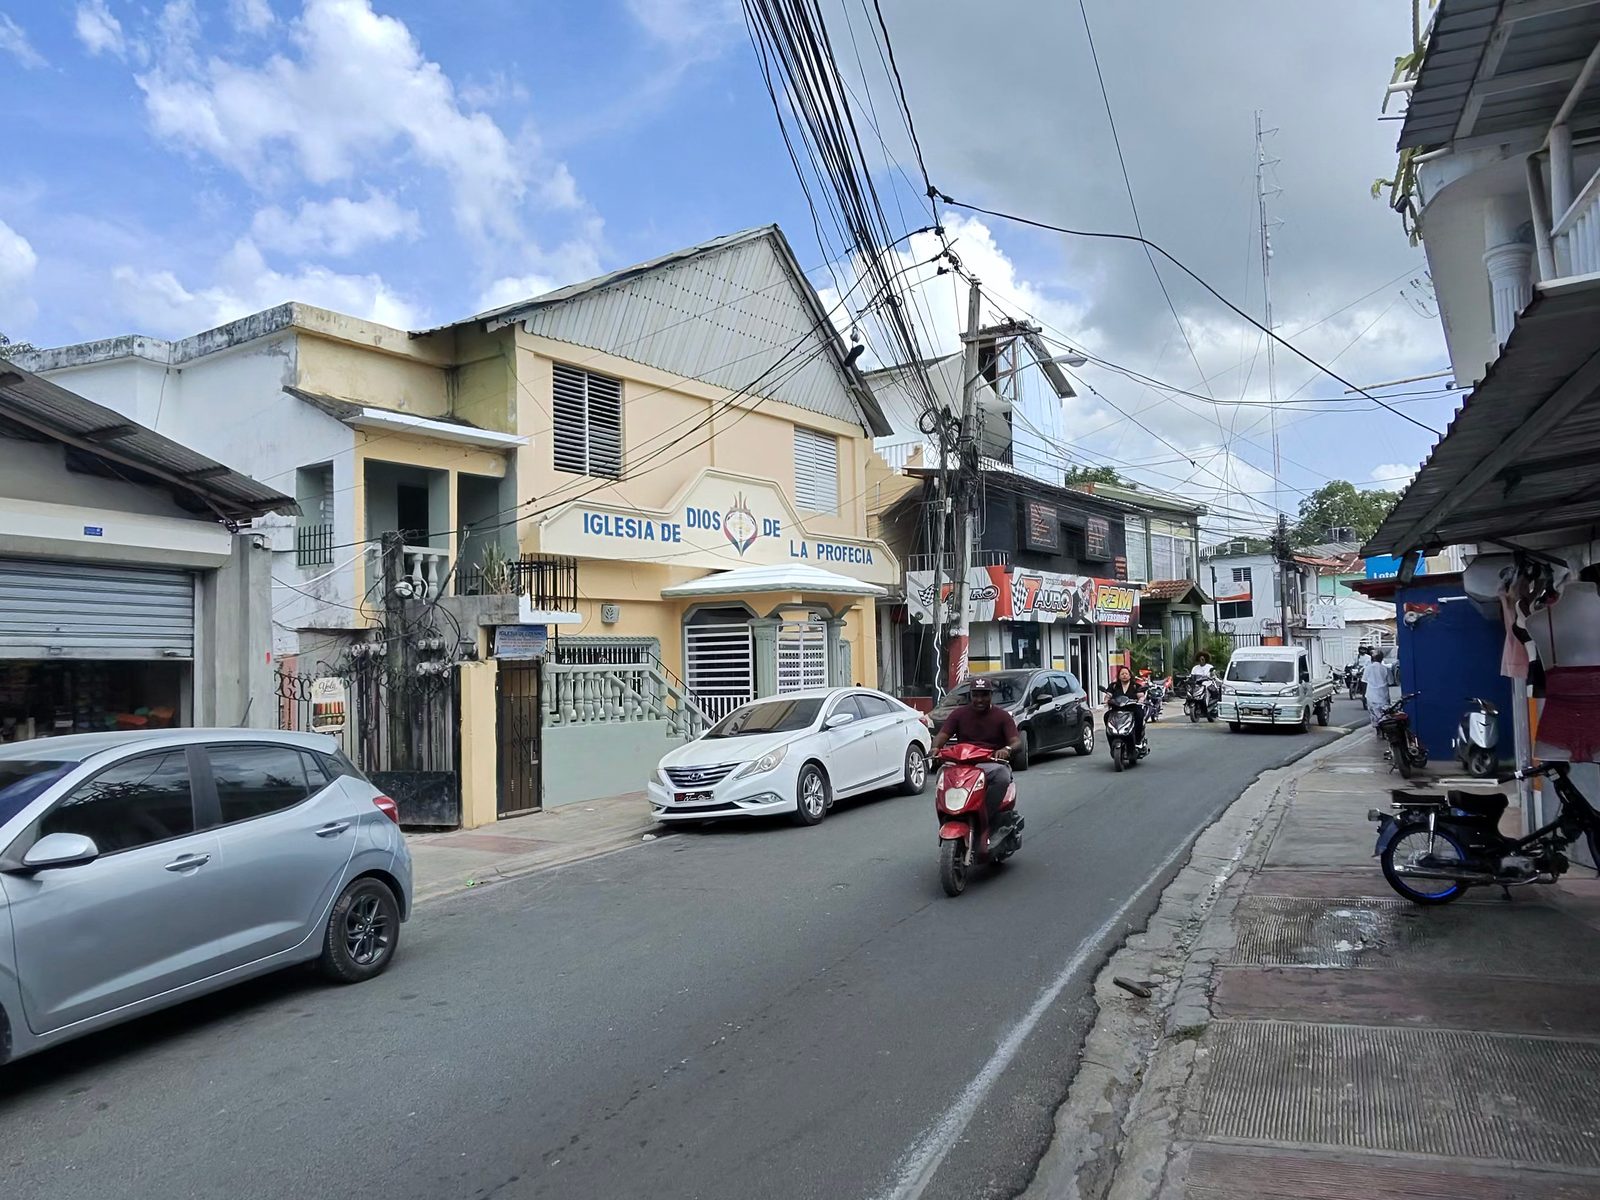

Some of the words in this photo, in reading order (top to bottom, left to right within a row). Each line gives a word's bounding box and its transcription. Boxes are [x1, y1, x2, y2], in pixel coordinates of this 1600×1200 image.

[583, 512, 655, 541] IGLESIA
[660, 522, 681, 543] DE
[686, 507, 721, 531] DIOS
[763, 518, 781, 538] DE
[790, 539, 808, 558] LA
[817, 543, 873, 565] PROFECIA
[1022, 576, 1073, 614] TAURO
